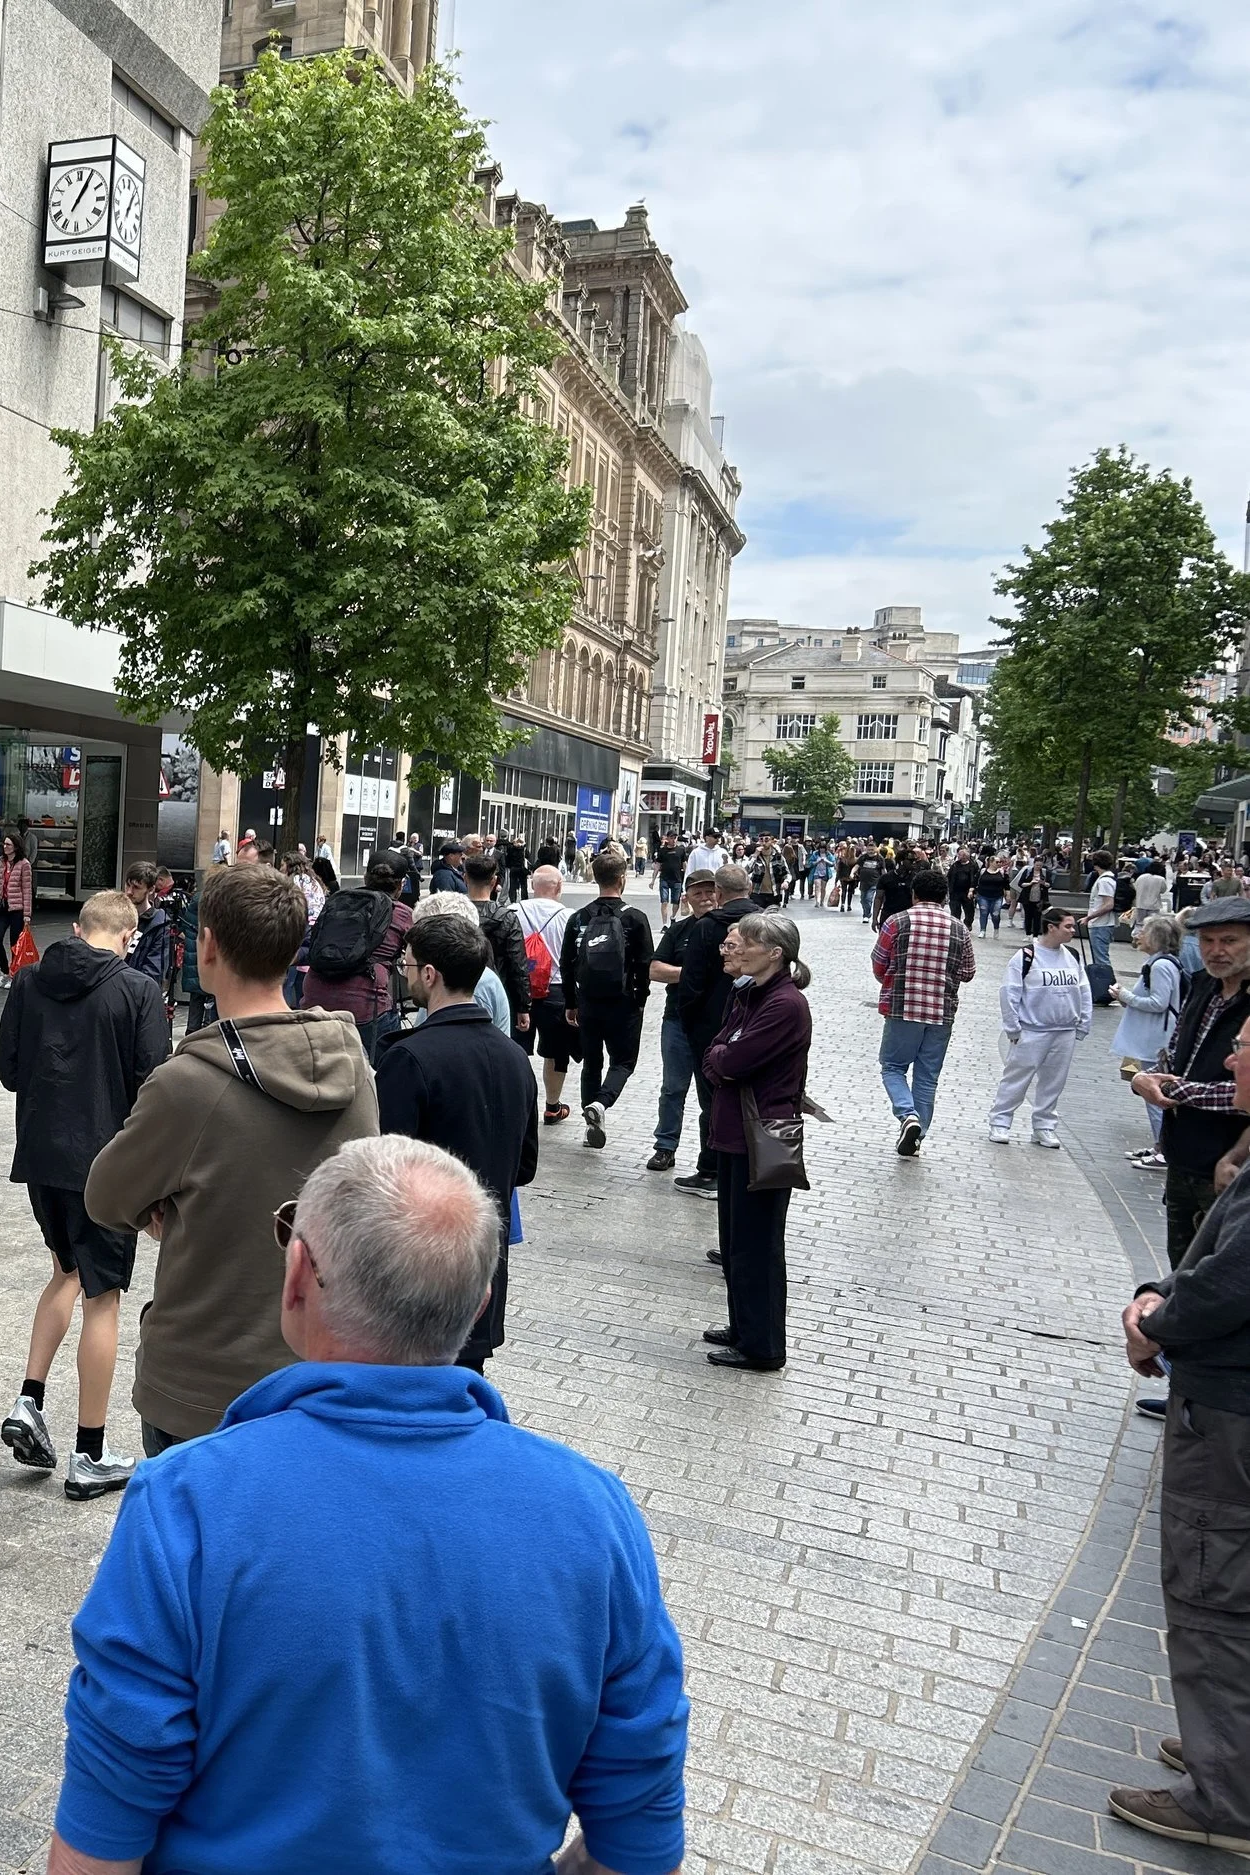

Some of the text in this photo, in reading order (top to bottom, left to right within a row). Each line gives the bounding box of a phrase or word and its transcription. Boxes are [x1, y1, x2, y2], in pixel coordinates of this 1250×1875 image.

[49, 246, 103, 257] KURT GEIGER
[1042, 970, 1078, 987] Dallas
